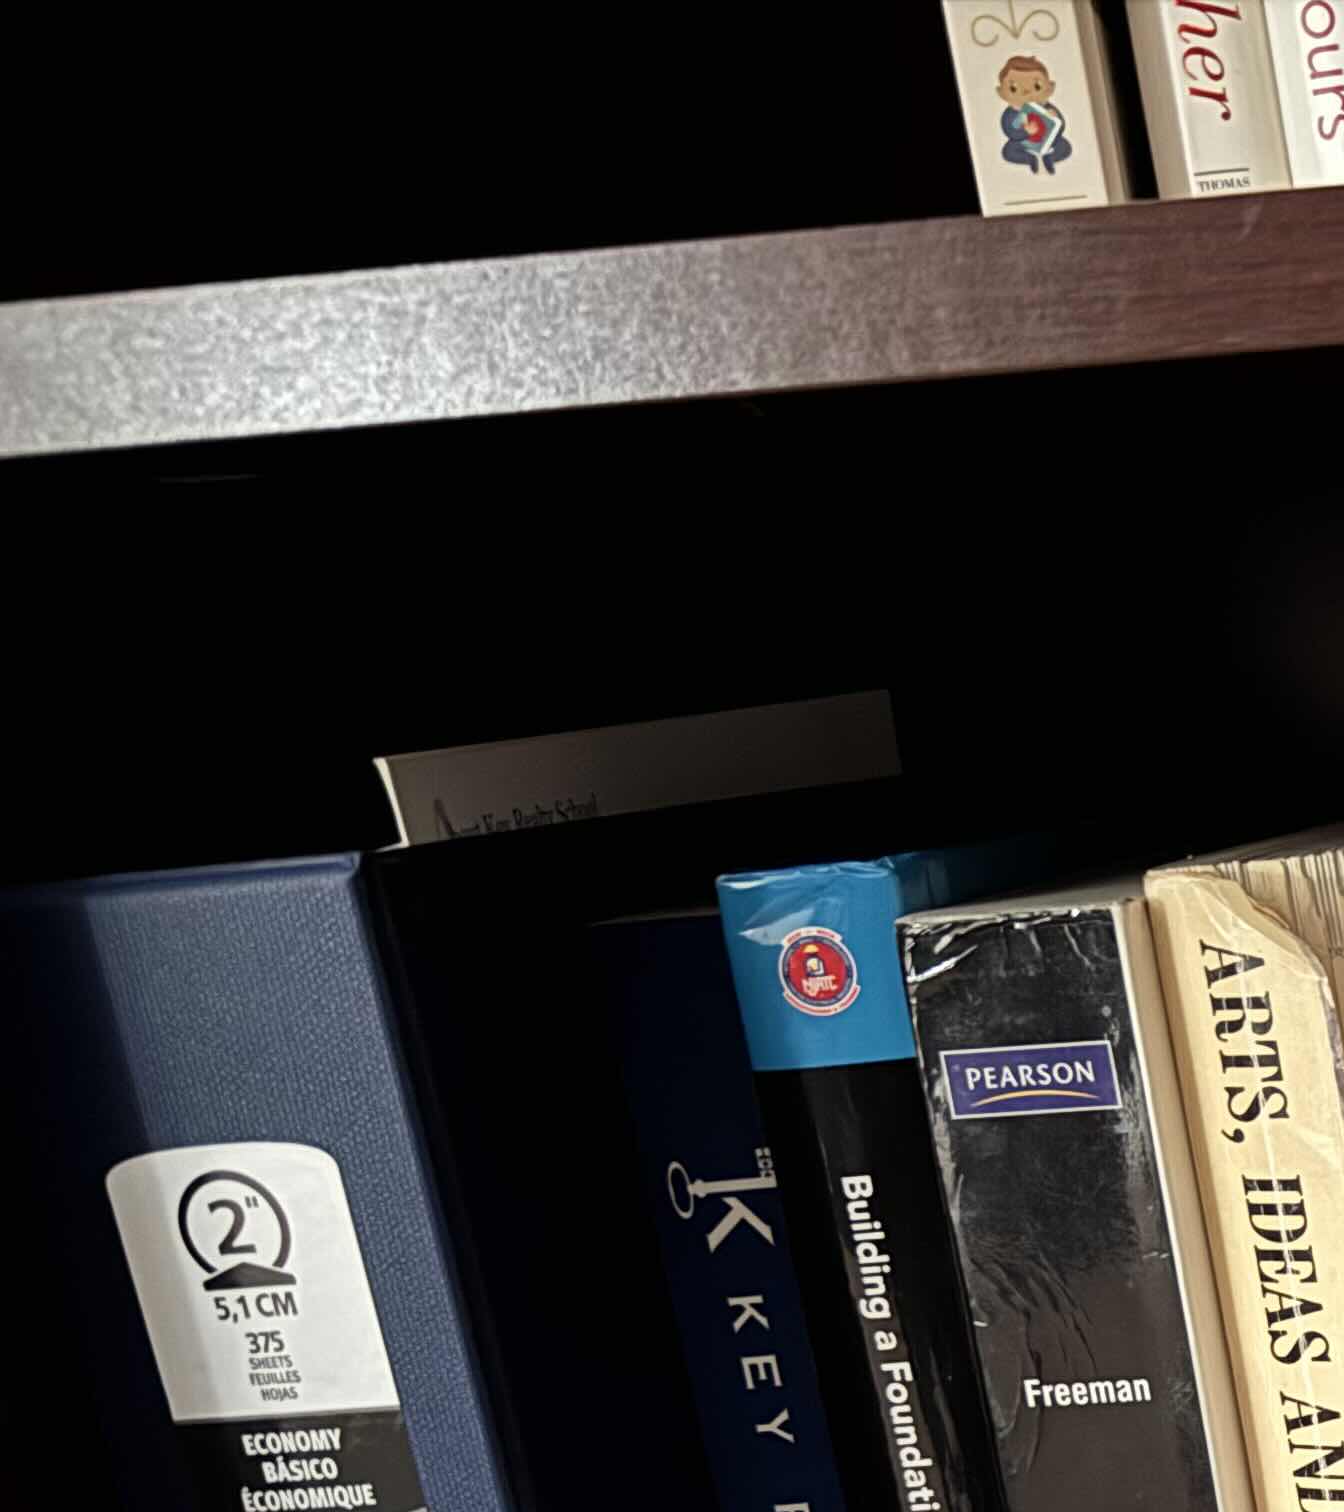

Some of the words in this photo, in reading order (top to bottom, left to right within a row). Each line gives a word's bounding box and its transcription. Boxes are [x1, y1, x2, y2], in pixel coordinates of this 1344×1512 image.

[1196, 175, 1251, 193] THOMAS
[1199, 938, 1292, 1144] ARTS,
[965, 1061, 1096, 1091] PEARSON
[840, 1173, 891, 1321] Building
[876, 1331, 898, 1352] a
[1241, 1173, 1332, 1366] IDEAS
[214, 1295, 251, 1321] 5,1
[256, 1293, 299, 1318] CM
[245, 1331, 285, 1355] 375
[248, 1356, 293, 1371] SHEETS
[726, 1294, 795, 1445] KEY
[249, 1370, 301, 1387] FEUILLES
[1023, 1377, 1152, 1409] Freeman
[260, 1386, 299, 1402] HOJAS
[241, 1429, 342, 1456] ECONOMY
[262, 1453, 338, 1483] BÁSICO
